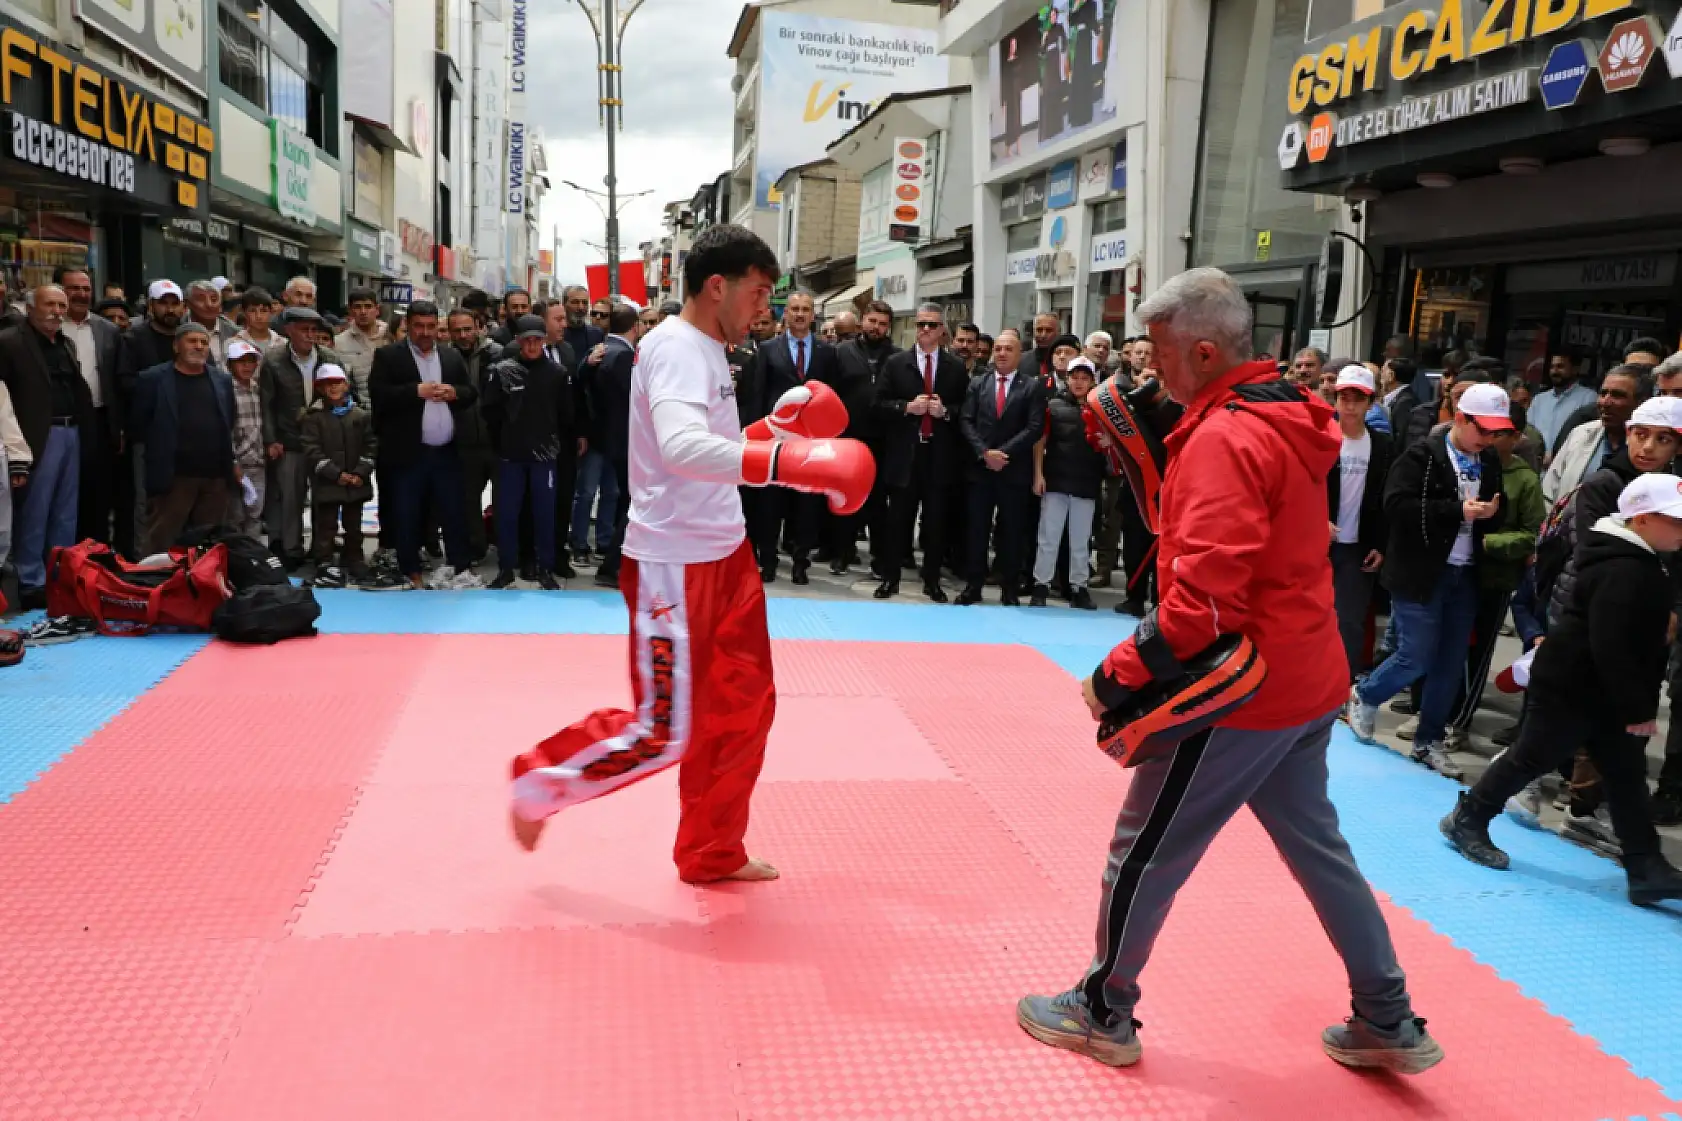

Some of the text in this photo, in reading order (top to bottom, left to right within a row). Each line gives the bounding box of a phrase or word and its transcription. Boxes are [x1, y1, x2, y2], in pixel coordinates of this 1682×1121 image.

[779, 26, 934, 56] Bir sonraki bankacılık için
[797, 43, 832, 58] Vinov
[511, 70, 526, 93] LC
[1287, 25, 1382, 115] GSM
[1542, 64, 1586, 85] SAMSUNG
[1, 27, 157, 163] FTELYA
[1432, 85, 1472, 124] ALIM
[1473, 68, 1530, 112] SATIMI
[13, 111, 135, 193] accessories
[510, 192, 523, 214] LC
[1094, 242, 1106, 262] LC
